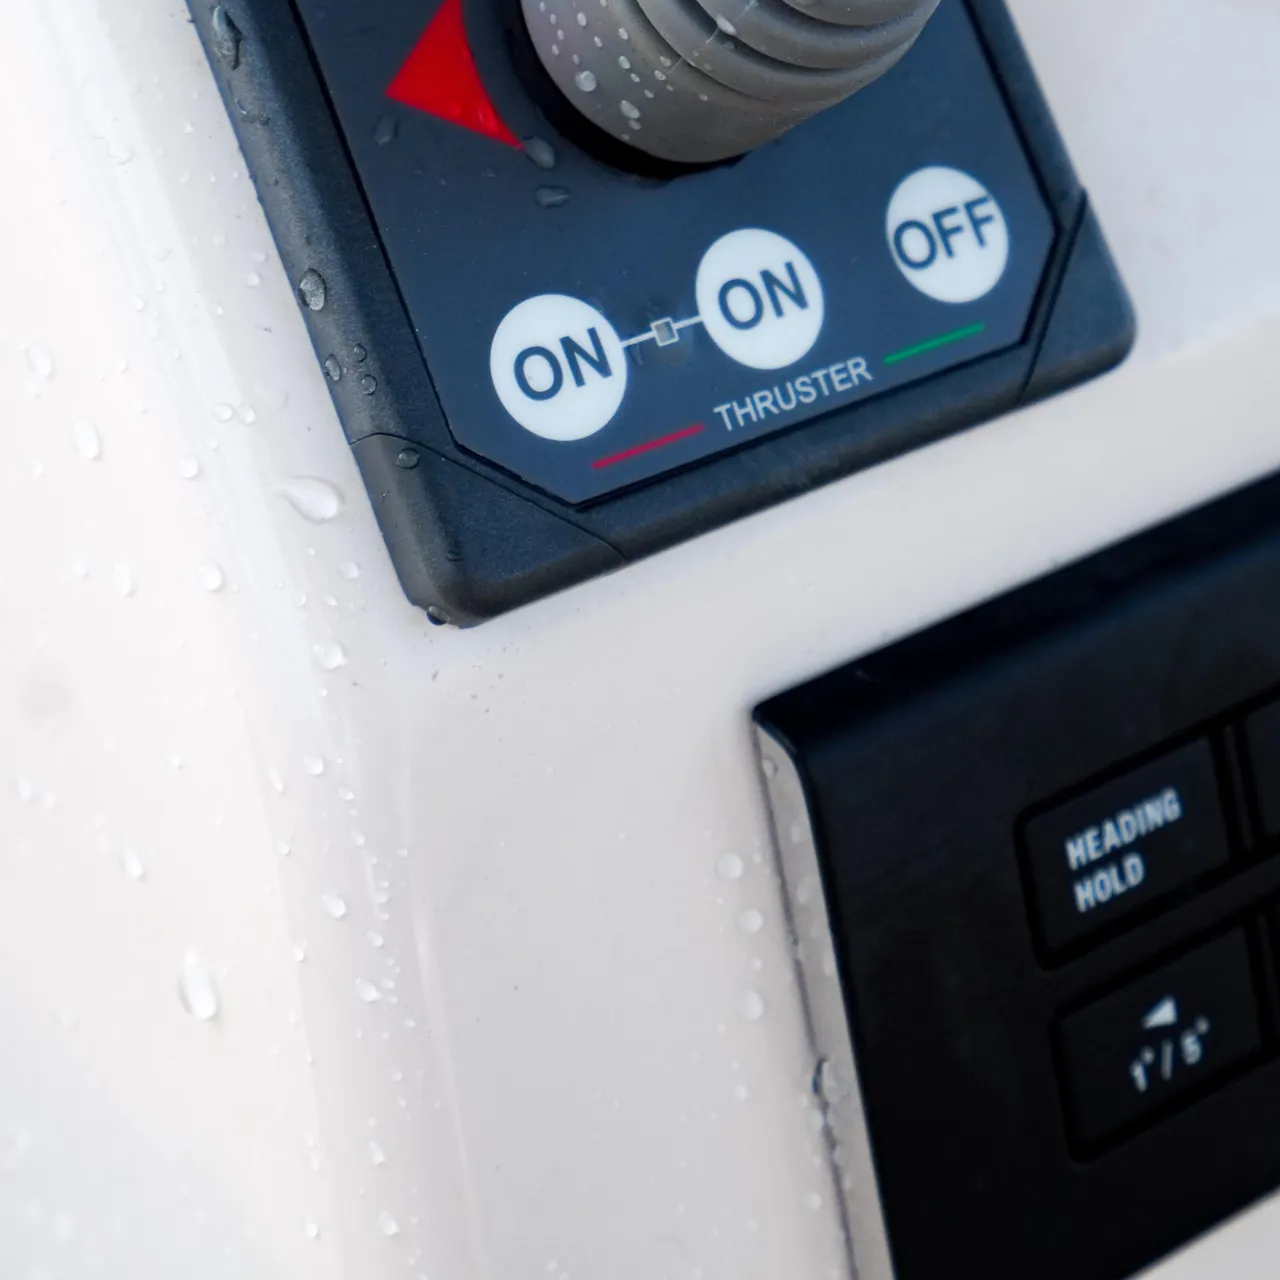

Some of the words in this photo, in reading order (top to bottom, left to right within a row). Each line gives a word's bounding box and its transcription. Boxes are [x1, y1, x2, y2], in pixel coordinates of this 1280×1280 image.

[892, 194, 1000, 270] OFF
[717, 261, 810, 331] ON
[512, 325, 613, 402] ON
[712, 355, 875, 432] THRUSTER
[1065, 786, 1182, 870] HEADING
[1074, 851, 1145, 913] HOLD
